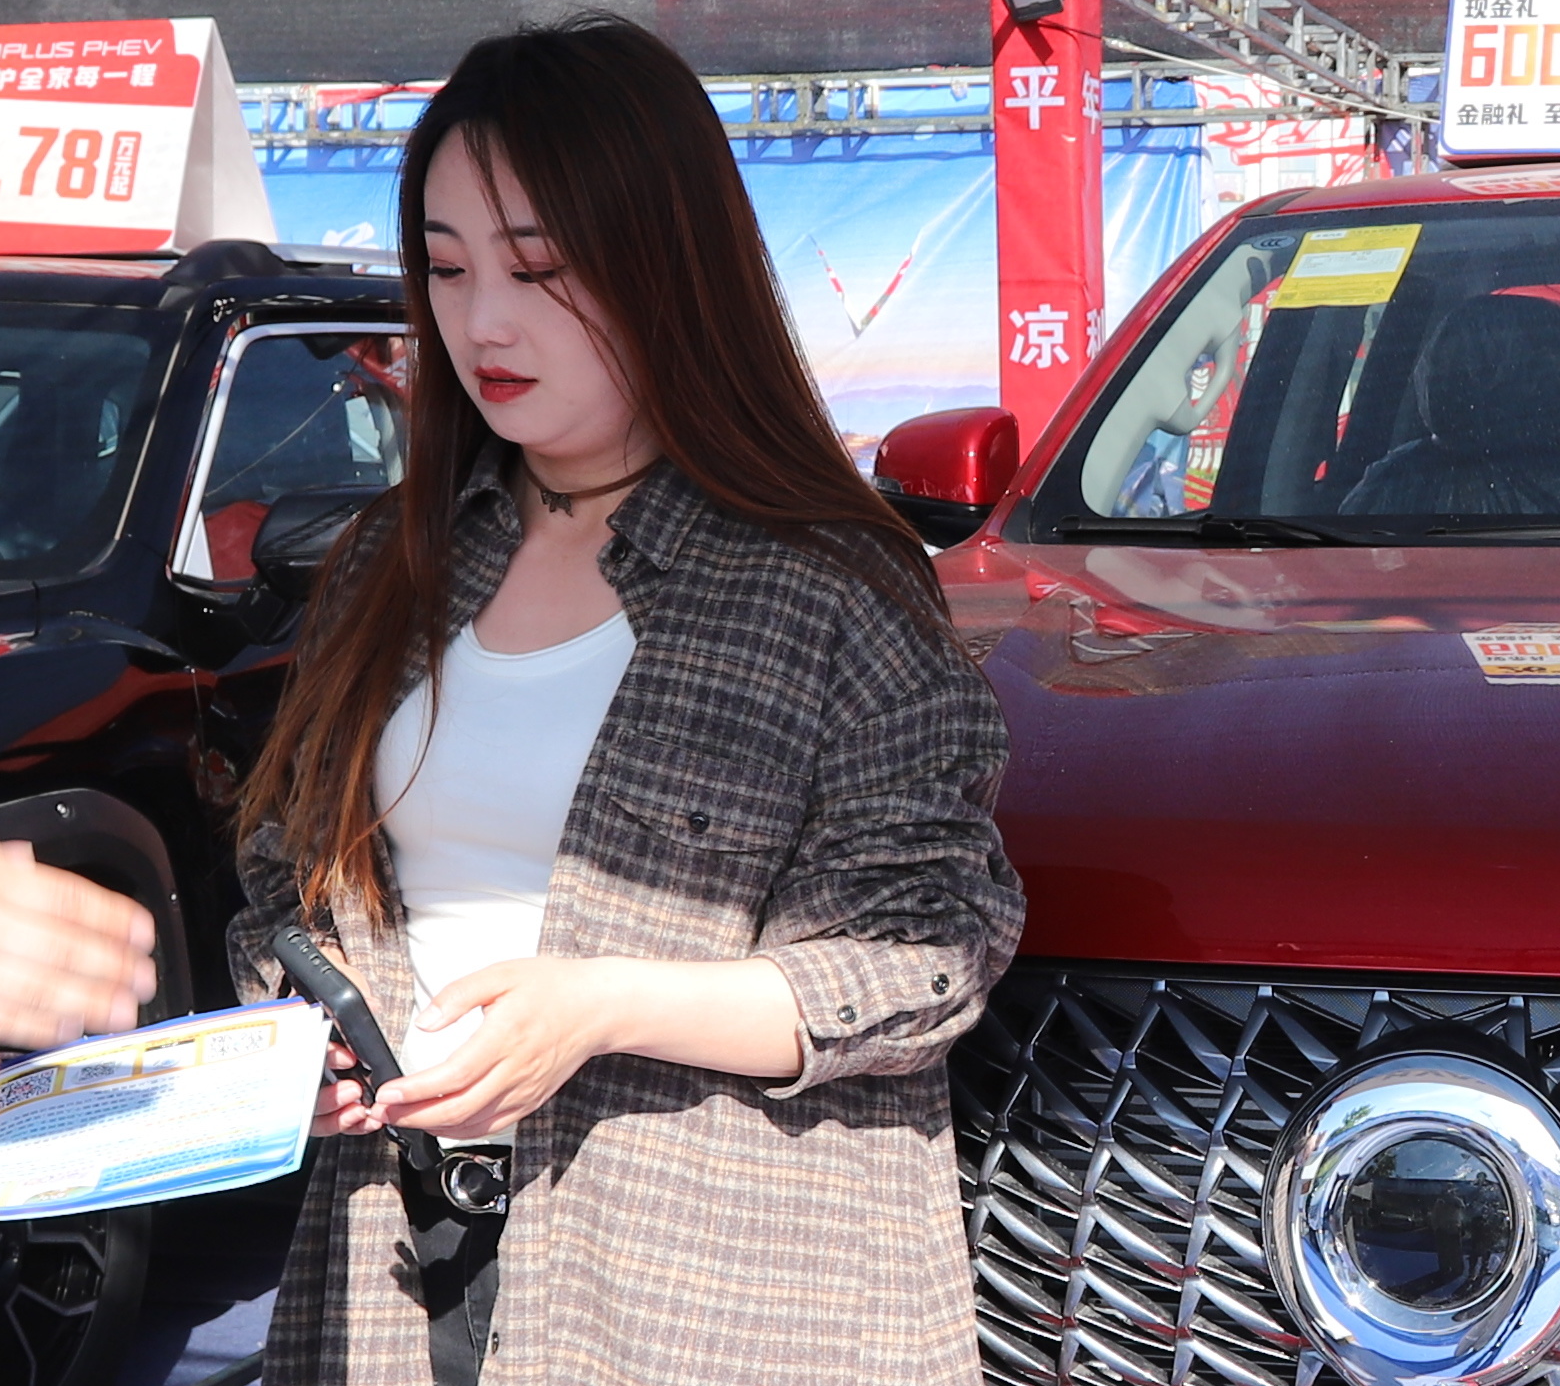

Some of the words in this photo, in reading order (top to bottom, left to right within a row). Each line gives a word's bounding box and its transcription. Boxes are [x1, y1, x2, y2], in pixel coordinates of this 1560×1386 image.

[82, 38, 164, 57] PHEV
[1456, 102, 1529, 126] 金融礼
[110, 136, 137, 196] 万元起
